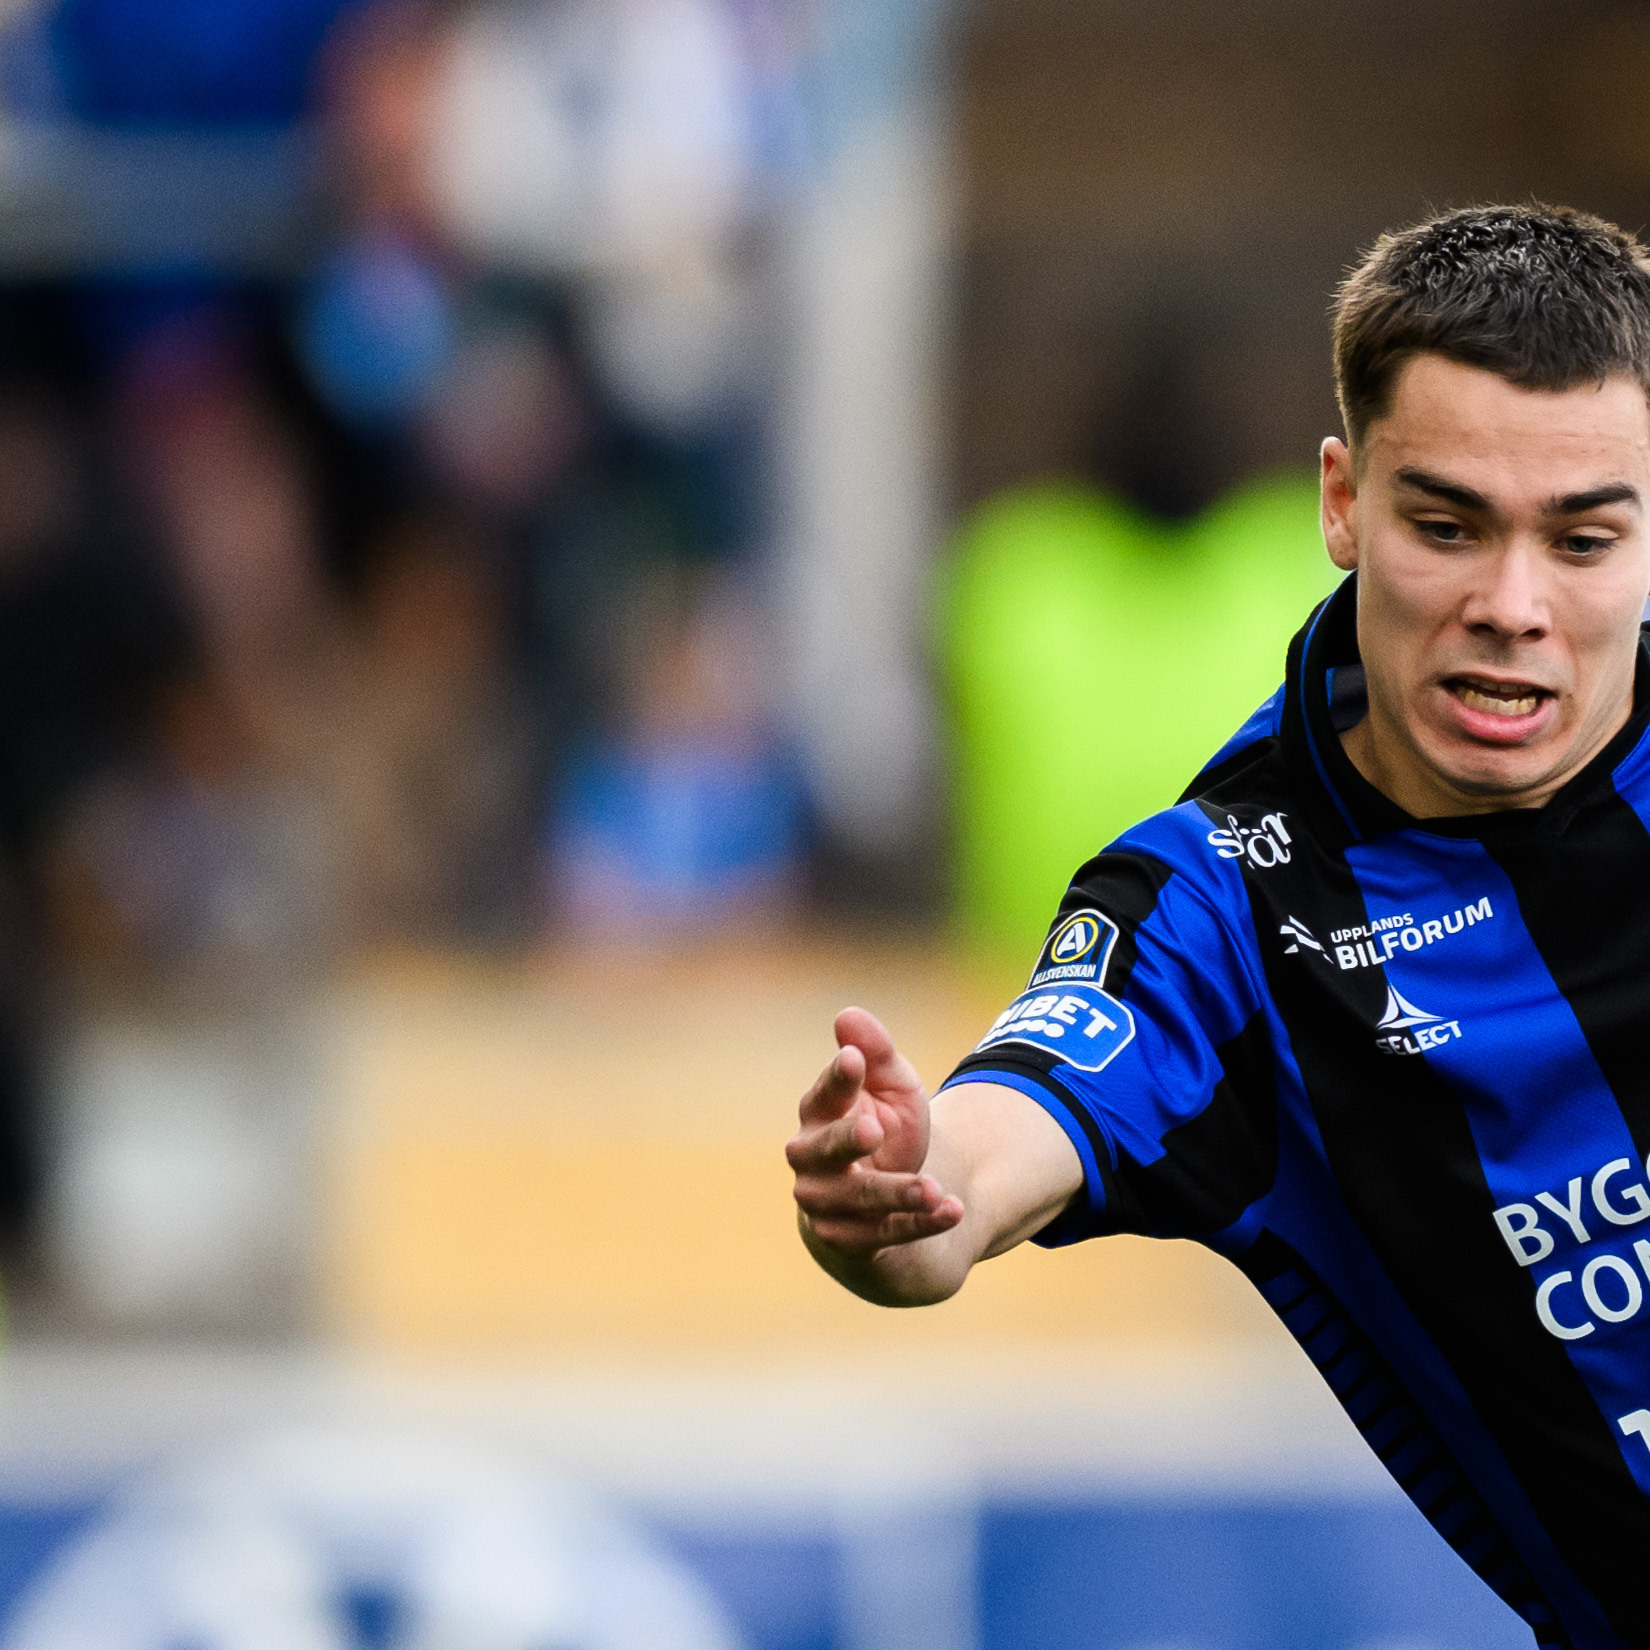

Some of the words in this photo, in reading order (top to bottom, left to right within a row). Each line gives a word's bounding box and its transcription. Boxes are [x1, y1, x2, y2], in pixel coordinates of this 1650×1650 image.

[1330, 912, 1414, 943] UPPLANDS
[1334, 896, 1494, 970] BILFORUM
[1375, 1021, 1463, 1055] SELECT
